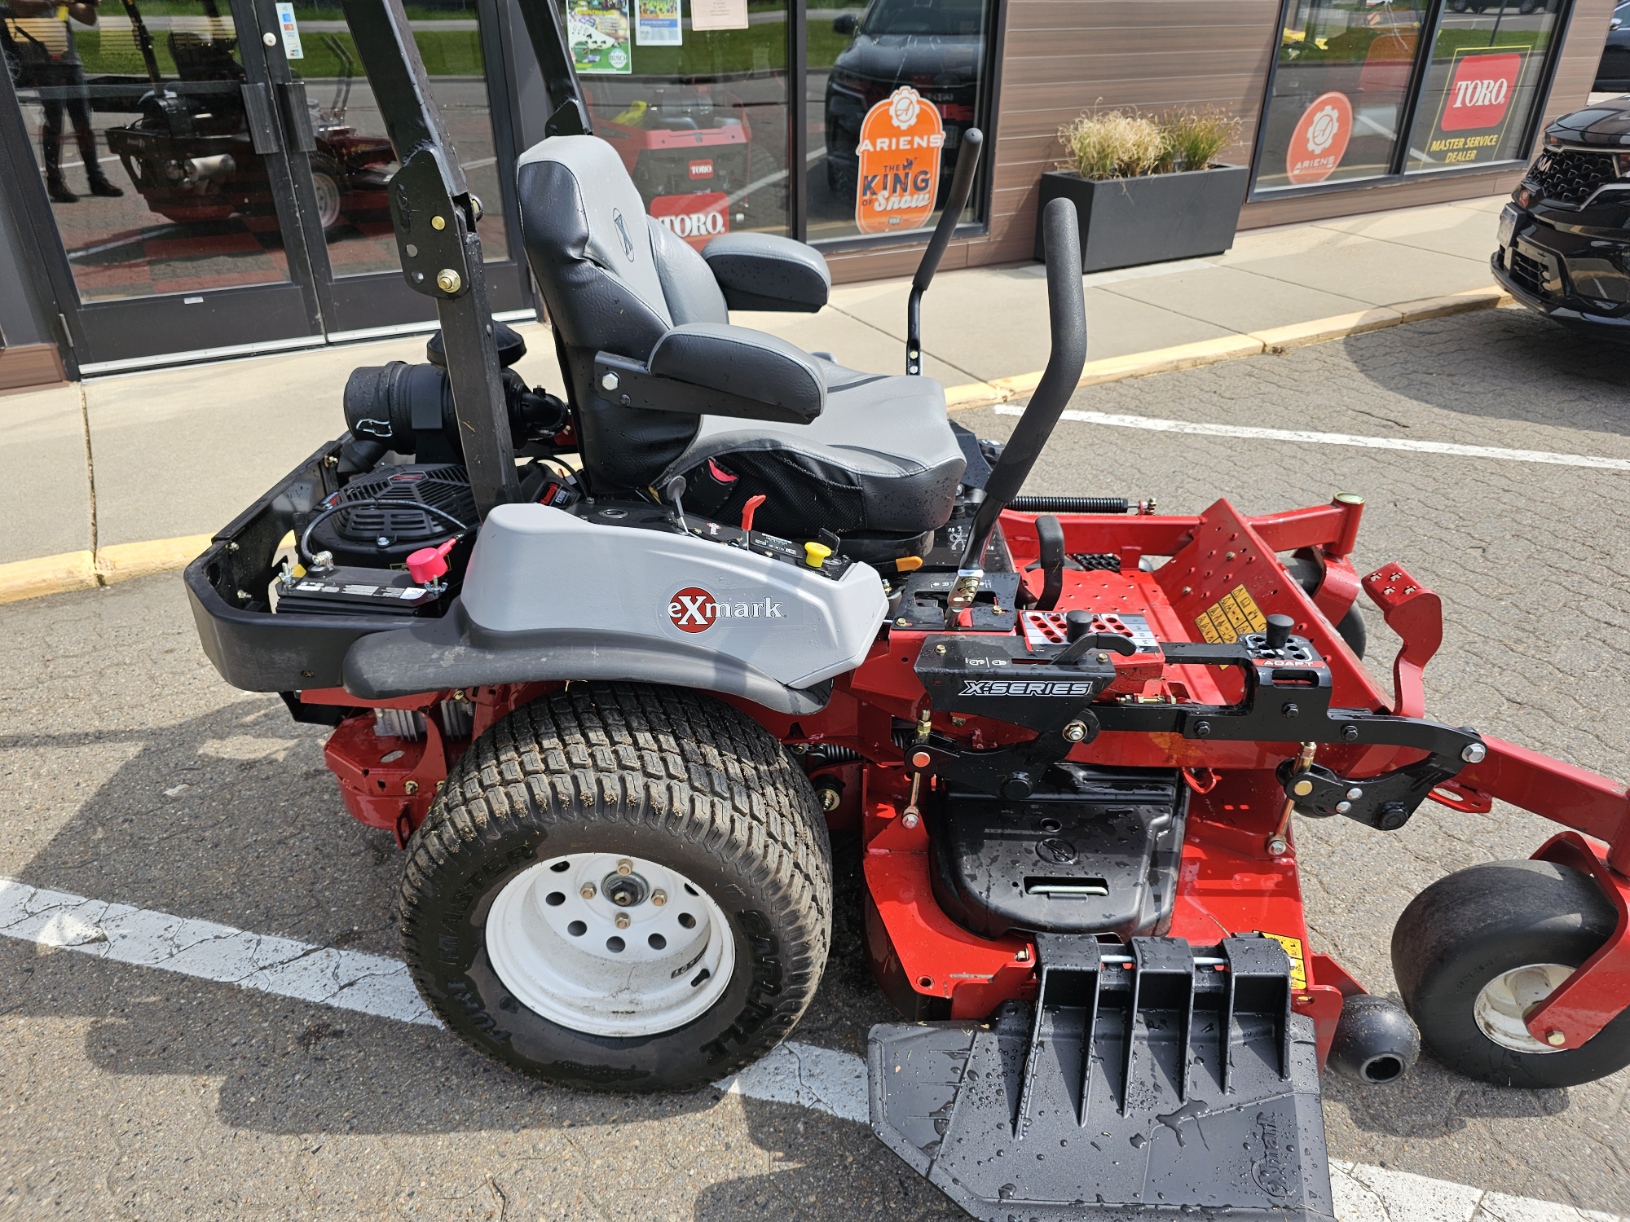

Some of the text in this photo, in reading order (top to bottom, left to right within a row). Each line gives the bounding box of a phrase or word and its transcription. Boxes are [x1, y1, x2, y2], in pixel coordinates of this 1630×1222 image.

[1453, 78, 1507, 107] TORO
[857, 134, 944, 153] ARIENS
[1430, 135, 1498, 151] MASTER SERVICE
[1293, 156, 1335, 174] ARIENS
[1445, 150, 1477, 163] DEALER
[690, 165, 712, 174] TORO
[883, 165, 900, 173] THE
[862, 170, 931, 197] KING
[874, 190, 931, 211] Snow
[658, 211, 724, 238] TORO
[438, 845, 538, 965] MASTER
[699, 910, 784, 1064] CARLISLE
